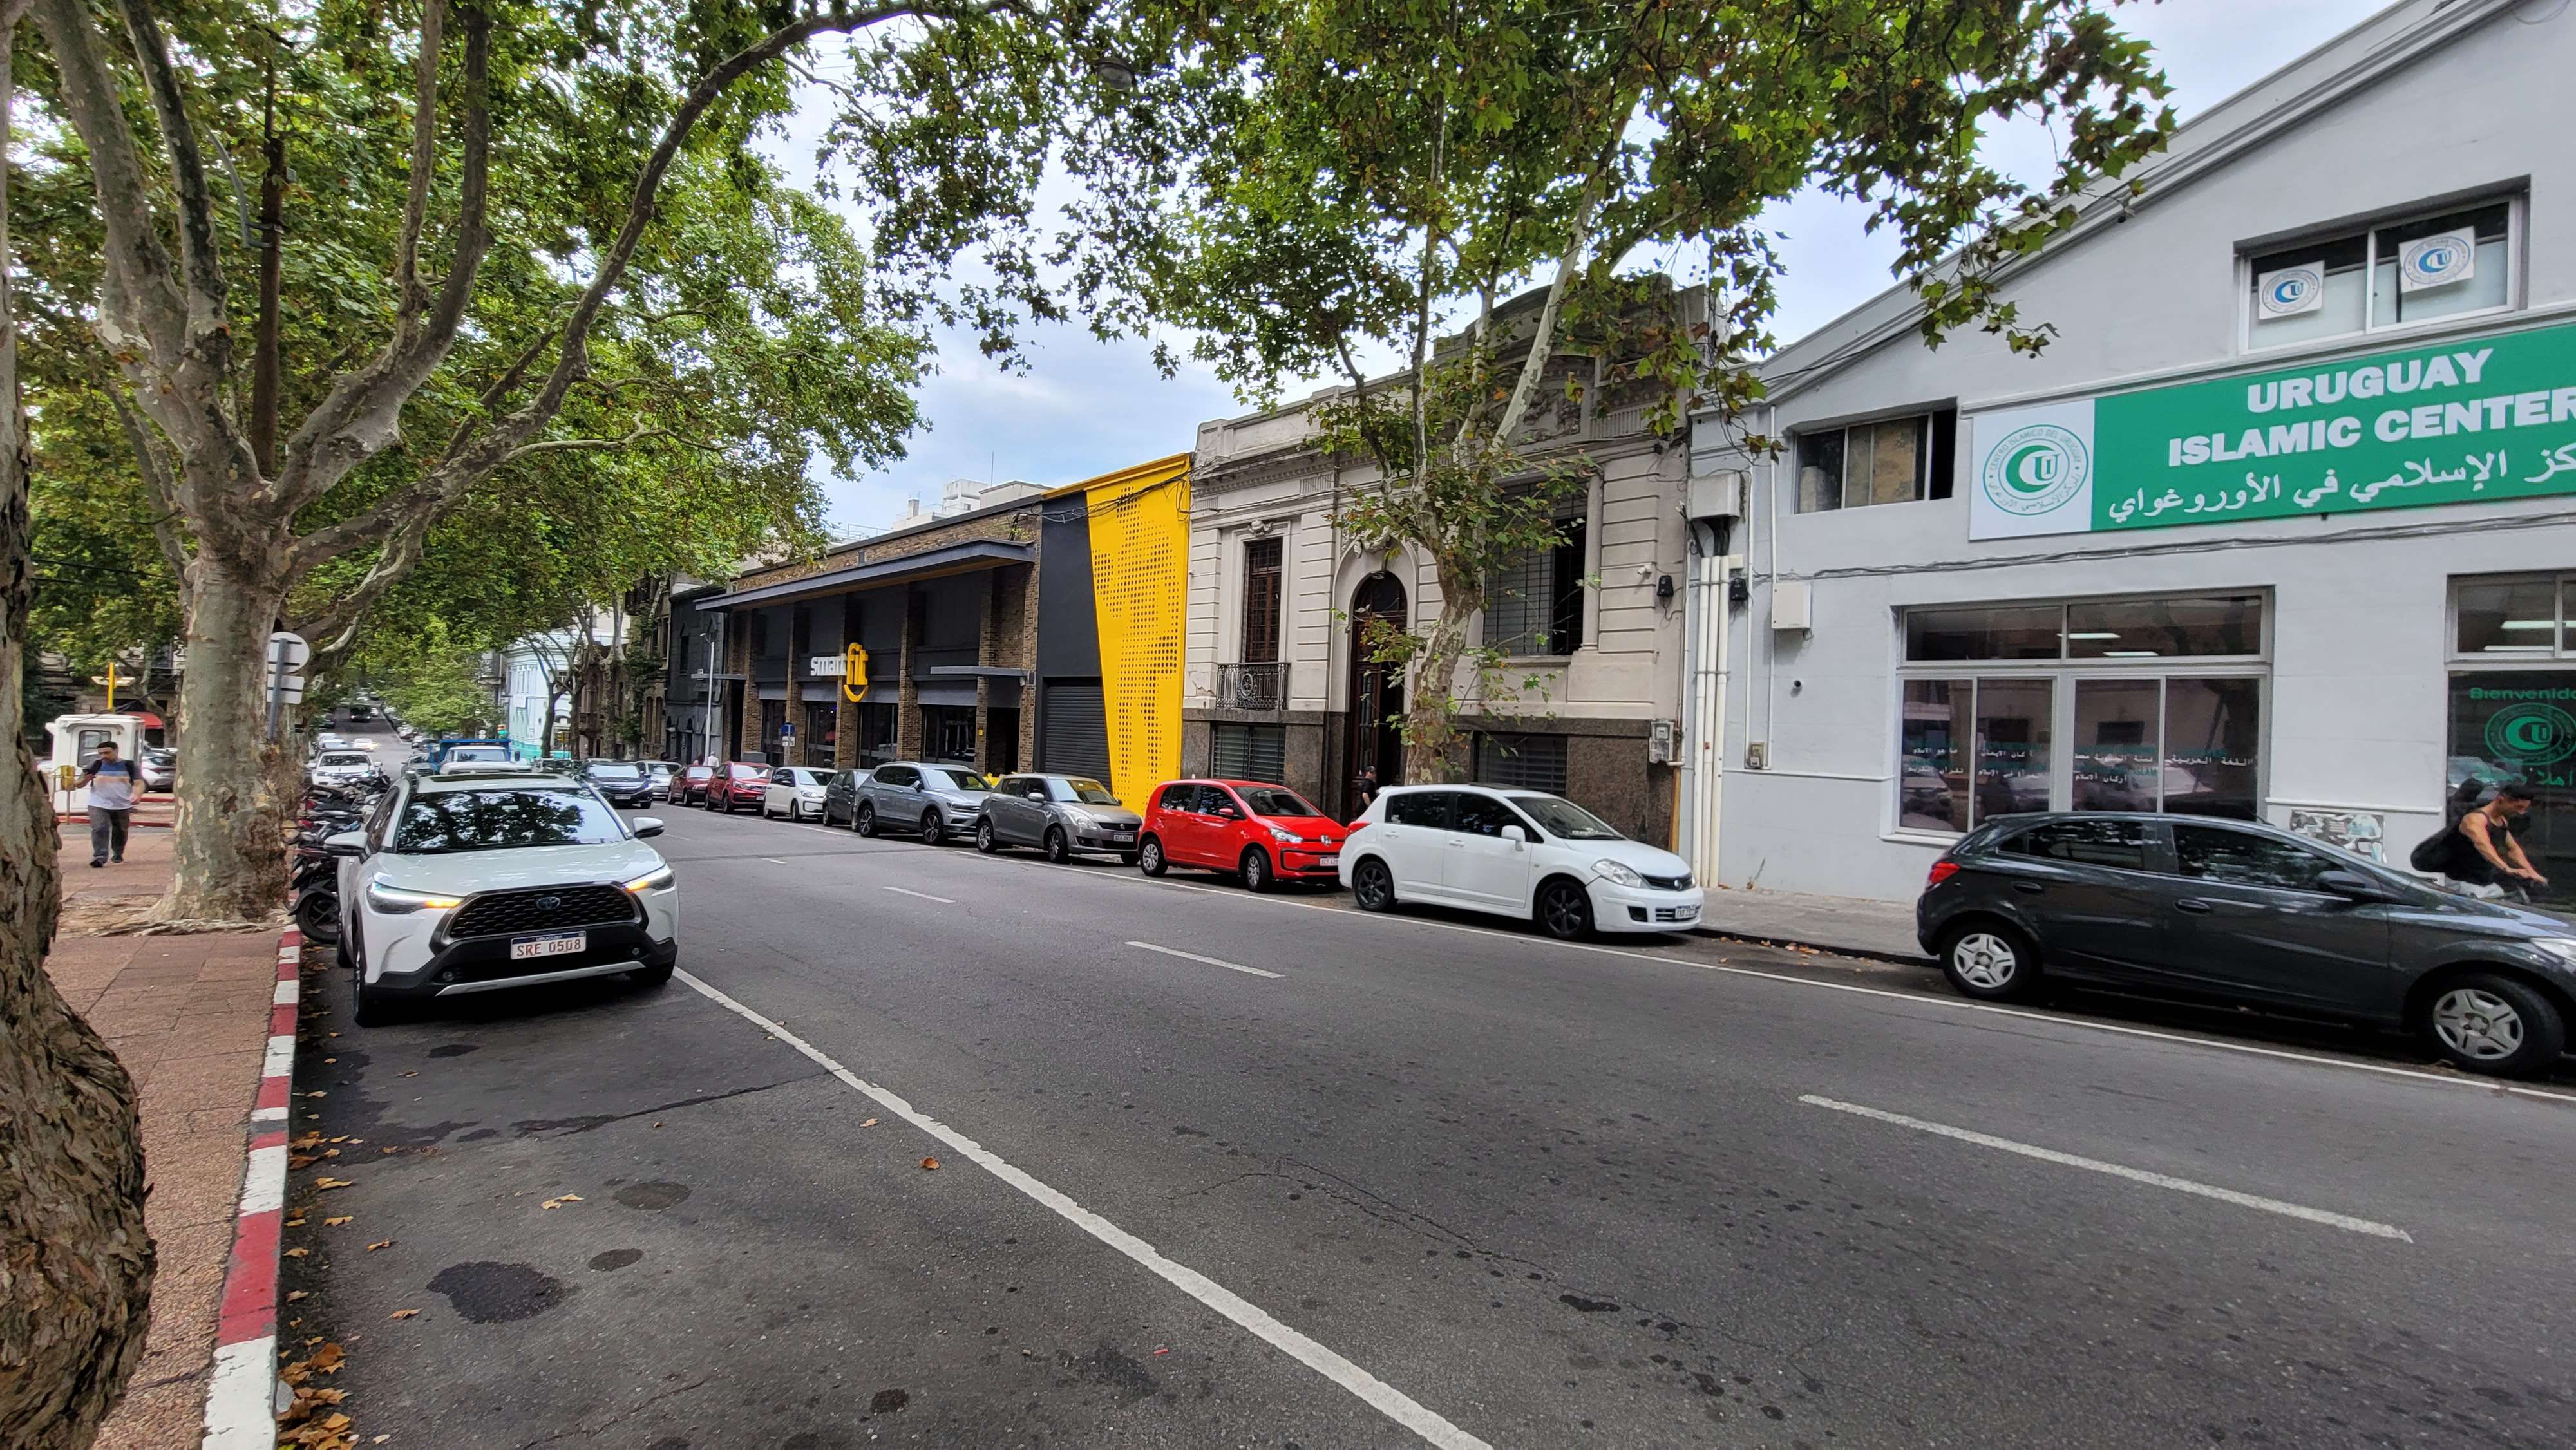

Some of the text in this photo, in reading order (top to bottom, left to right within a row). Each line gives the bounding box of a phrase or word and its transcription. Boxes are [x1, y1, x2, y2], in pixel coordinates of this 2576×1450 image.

[2247, 348, 2494, 413] URUGUAY
[2168, 386, 2576, 467] ISLAMIC CENTER
[2108, 471, 2282, 523] الأوروغواي
[2293, 469, 2339, 508] في
[2349, 448, 2508, 504] الإسلامي
[810, 642, 868, 686] smart fit
[516, 939, 582, 957] SRE 0508
